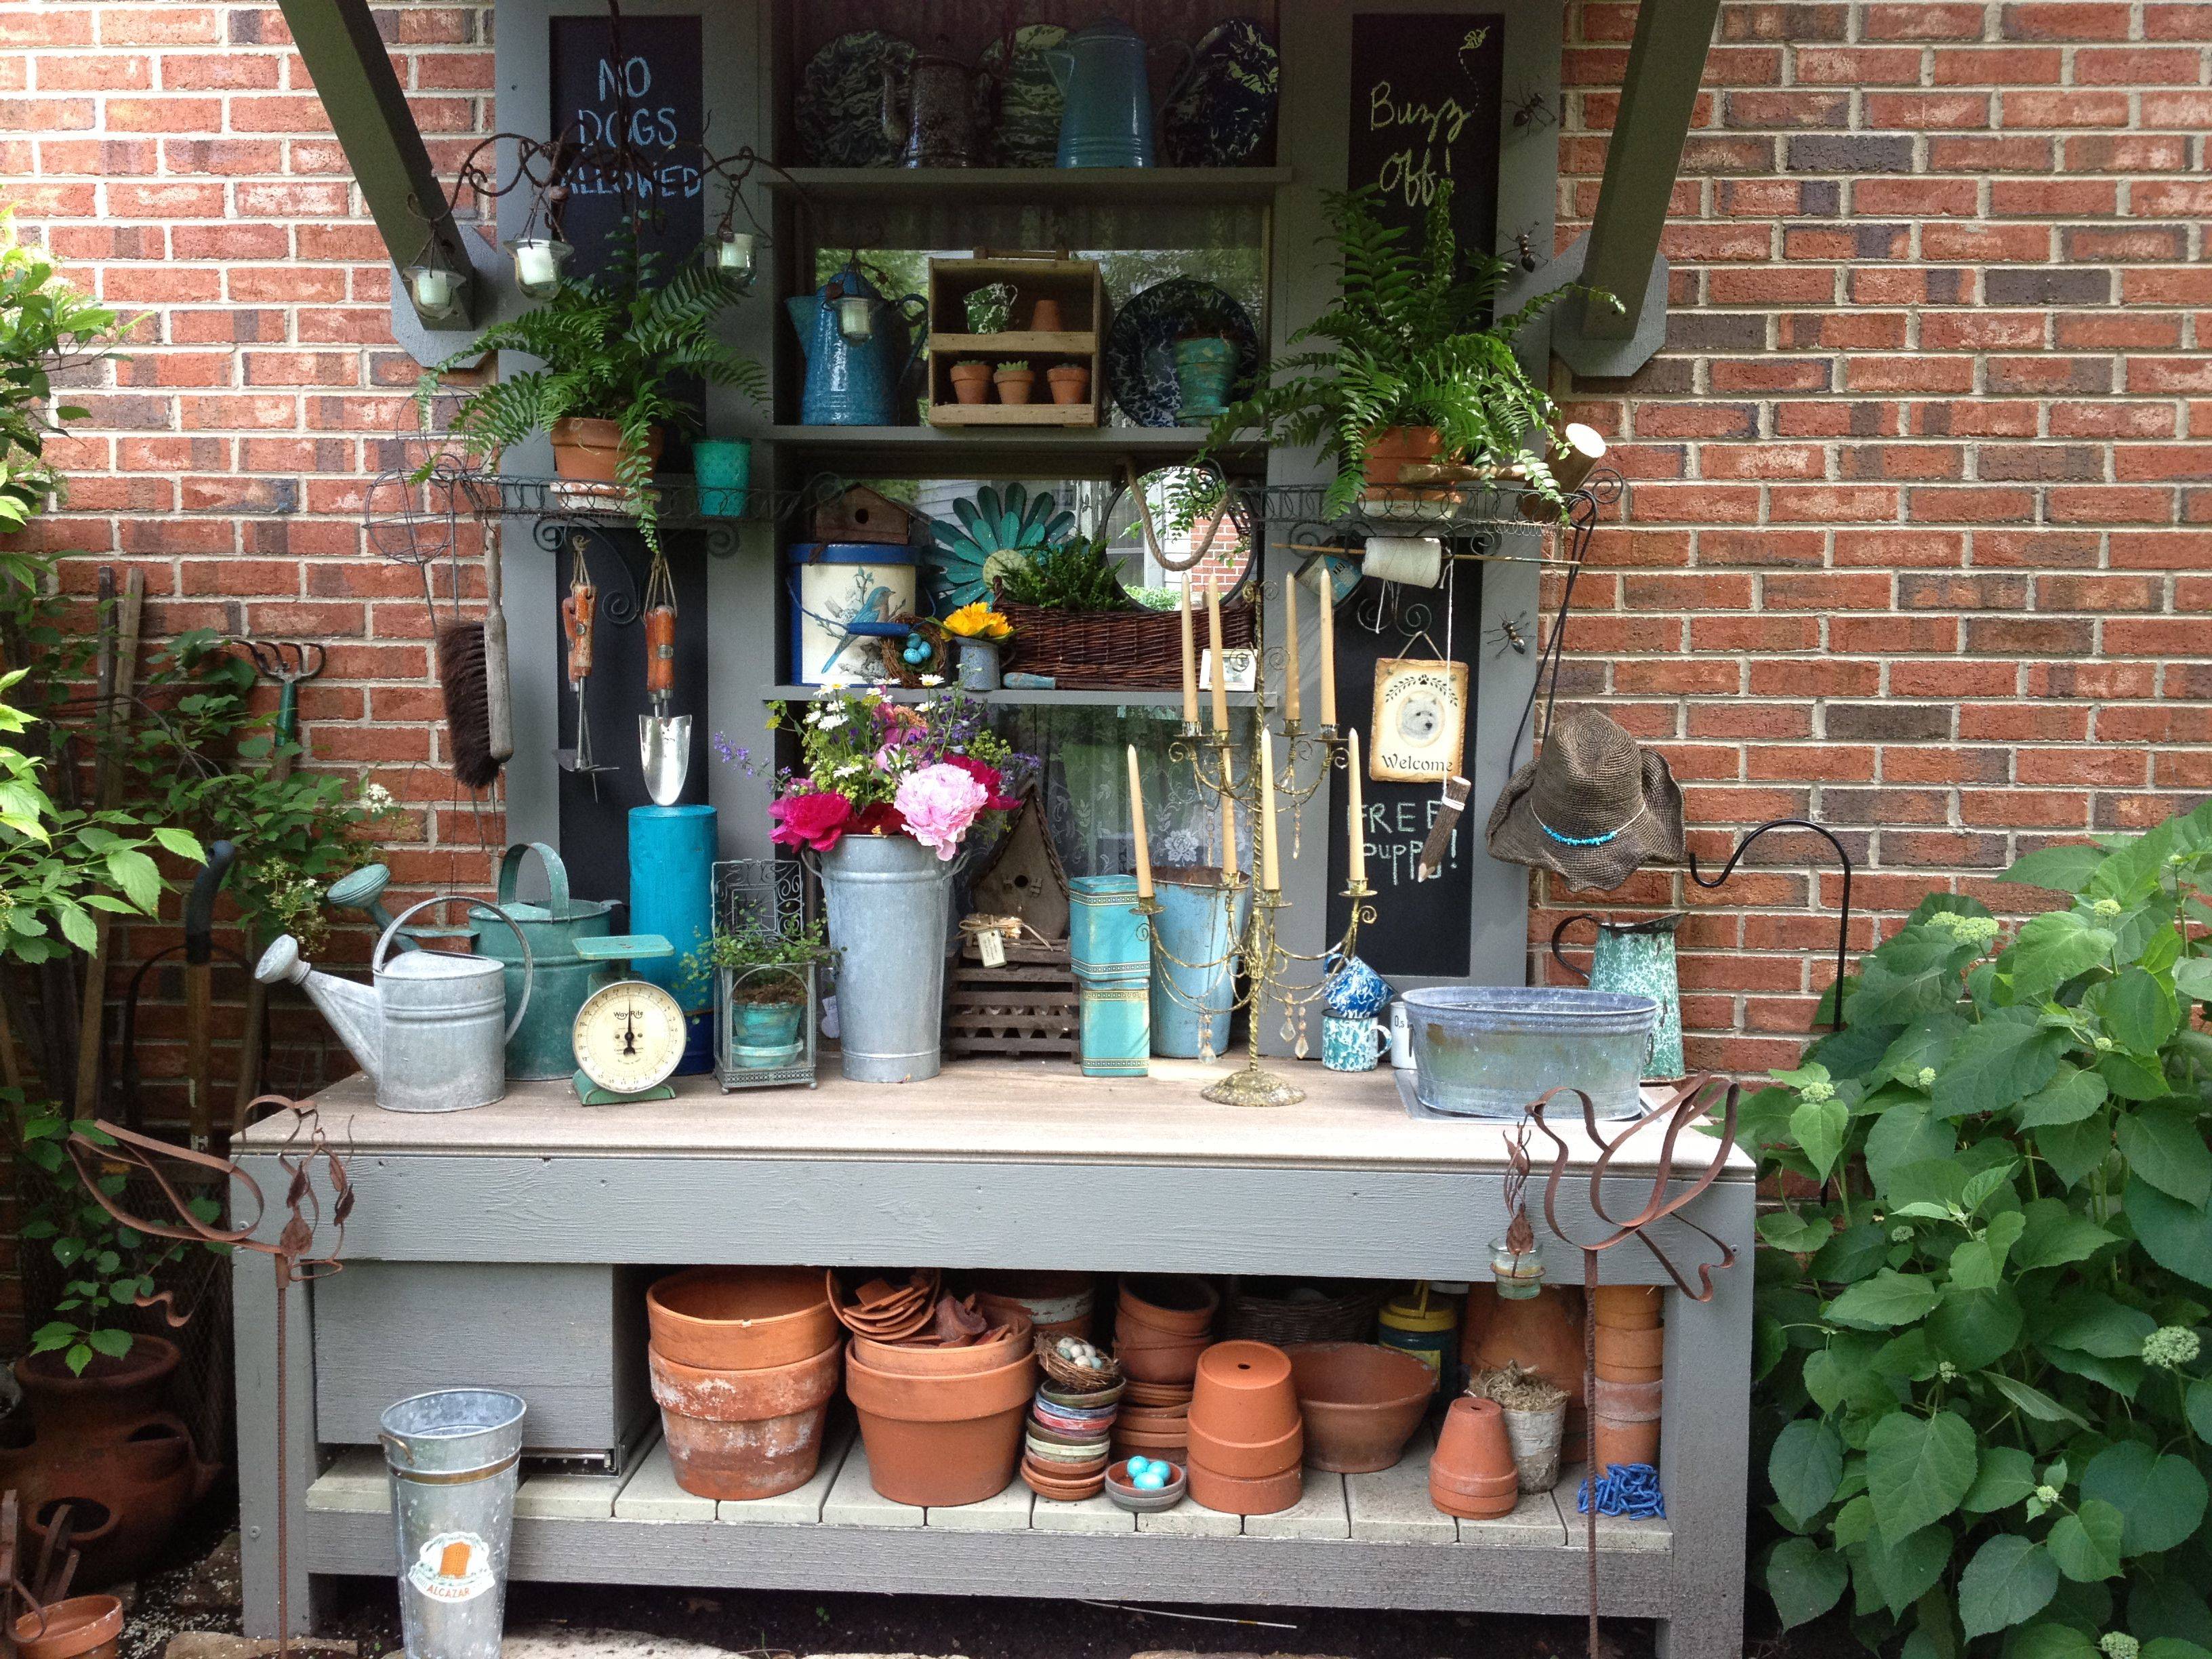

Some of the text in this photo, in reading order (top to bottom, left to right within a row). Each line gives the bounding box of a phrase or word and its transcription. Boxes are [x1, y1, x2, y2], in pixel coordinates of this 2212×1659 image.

[598, 56, 651, 101] NO
[578, 108, 677, 148] DOGS
[1381, 752, 1454, 773] Welcome
[613, 1009, 644, 1020] Way Rite
[426, 1584, 470, 1598] ALCAZAR
